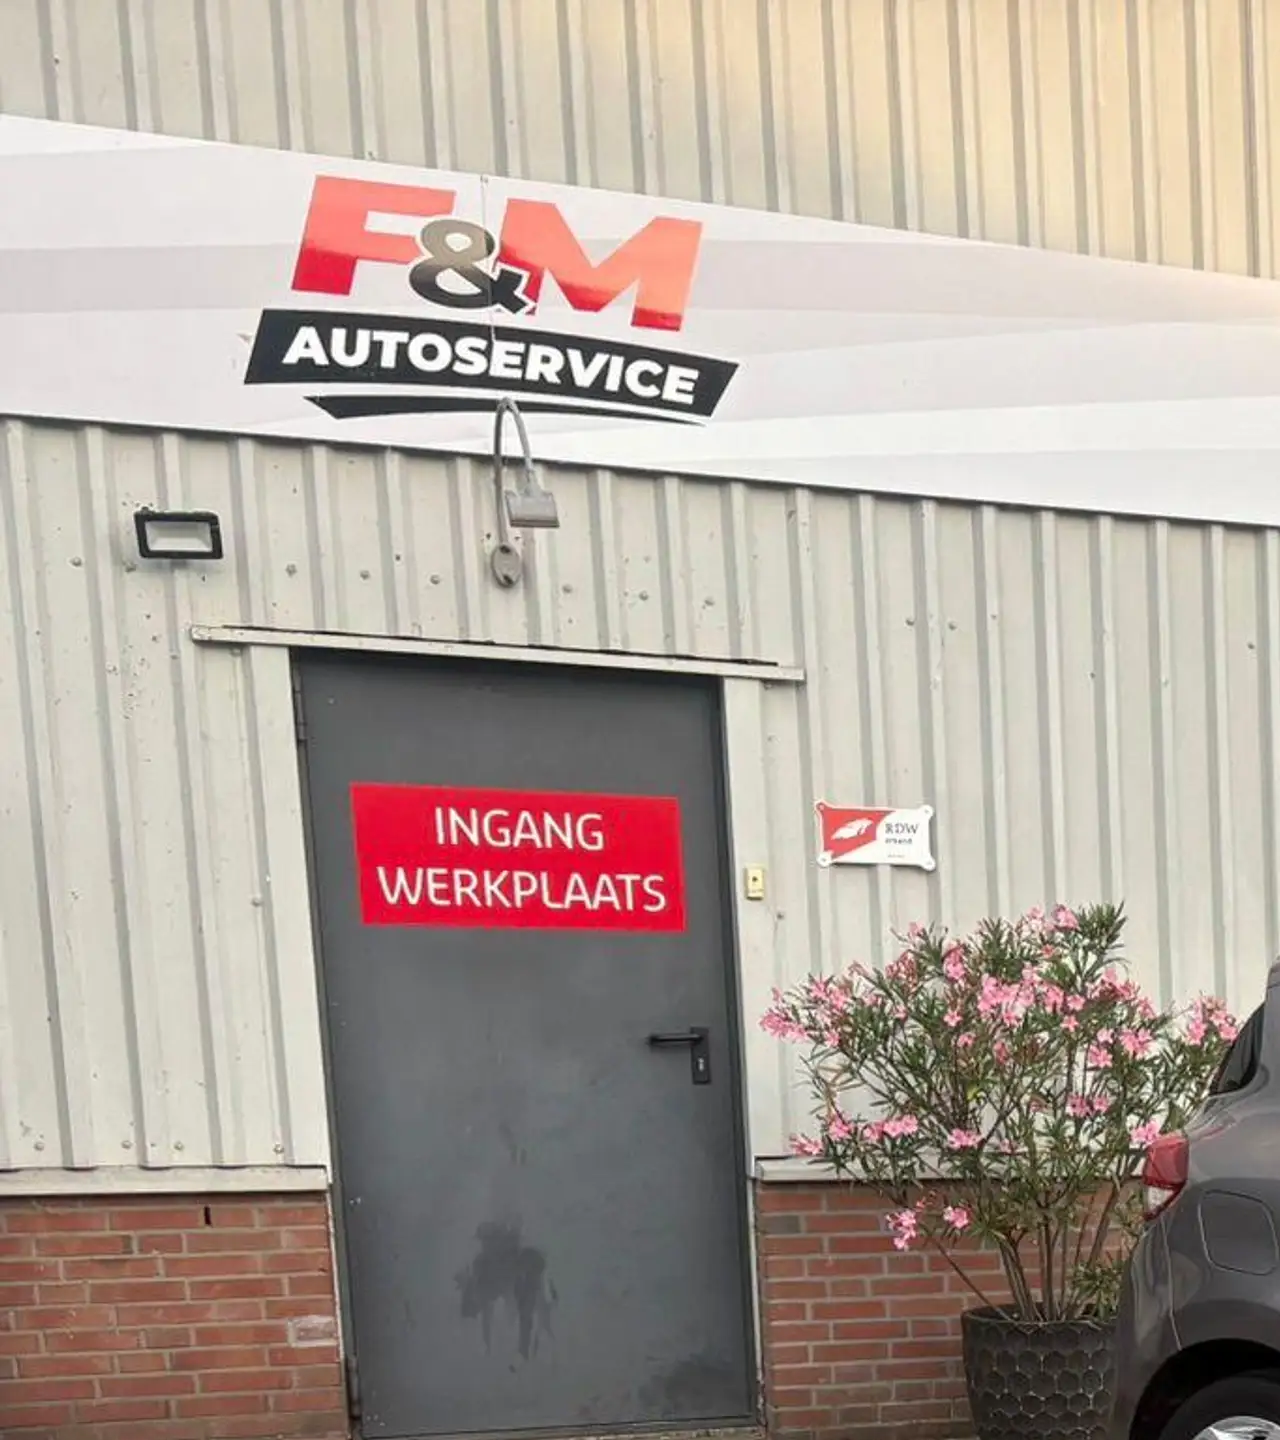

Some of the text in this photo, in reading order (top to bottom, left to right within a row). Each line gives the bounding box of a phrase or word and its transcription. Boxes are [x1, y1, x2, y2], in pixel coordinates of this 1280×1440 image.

[291, 174, 704, 332] F&M
[281, 326, 700, 406] AUTOSERVICE
[435, 806, 604, 851] INGANG
[885, 822, 919, 834] RDW
[376, 865, 667, 913] WERKPLAATS
